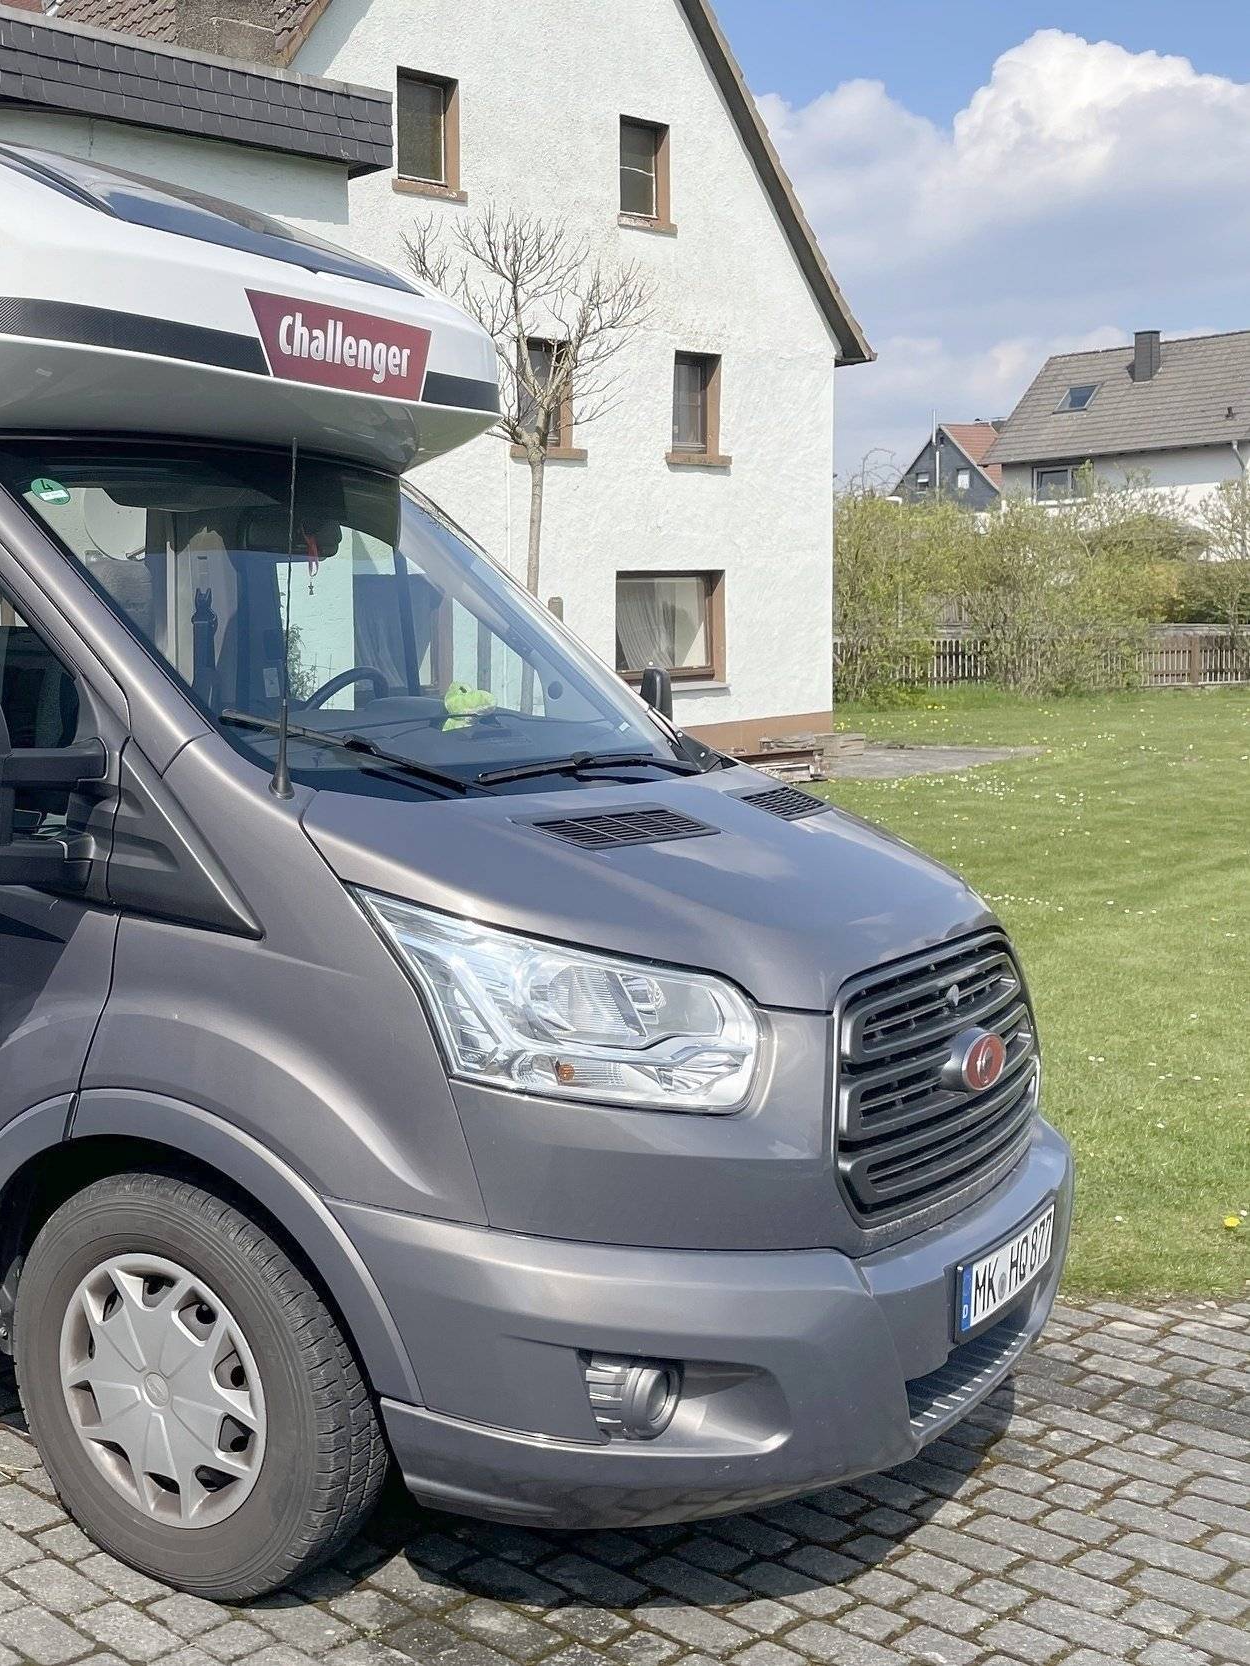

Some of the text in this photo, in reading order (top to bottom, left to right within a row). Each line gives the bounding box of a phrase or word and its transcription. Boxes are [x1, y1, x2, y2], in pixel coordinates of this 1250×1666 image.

[279, 312, 410, 384] Challenger
[40, 480, 54, 491] 4
[974, 1256, 999, 1318] MK
[1030, 1210, 1053, 1272] 877
